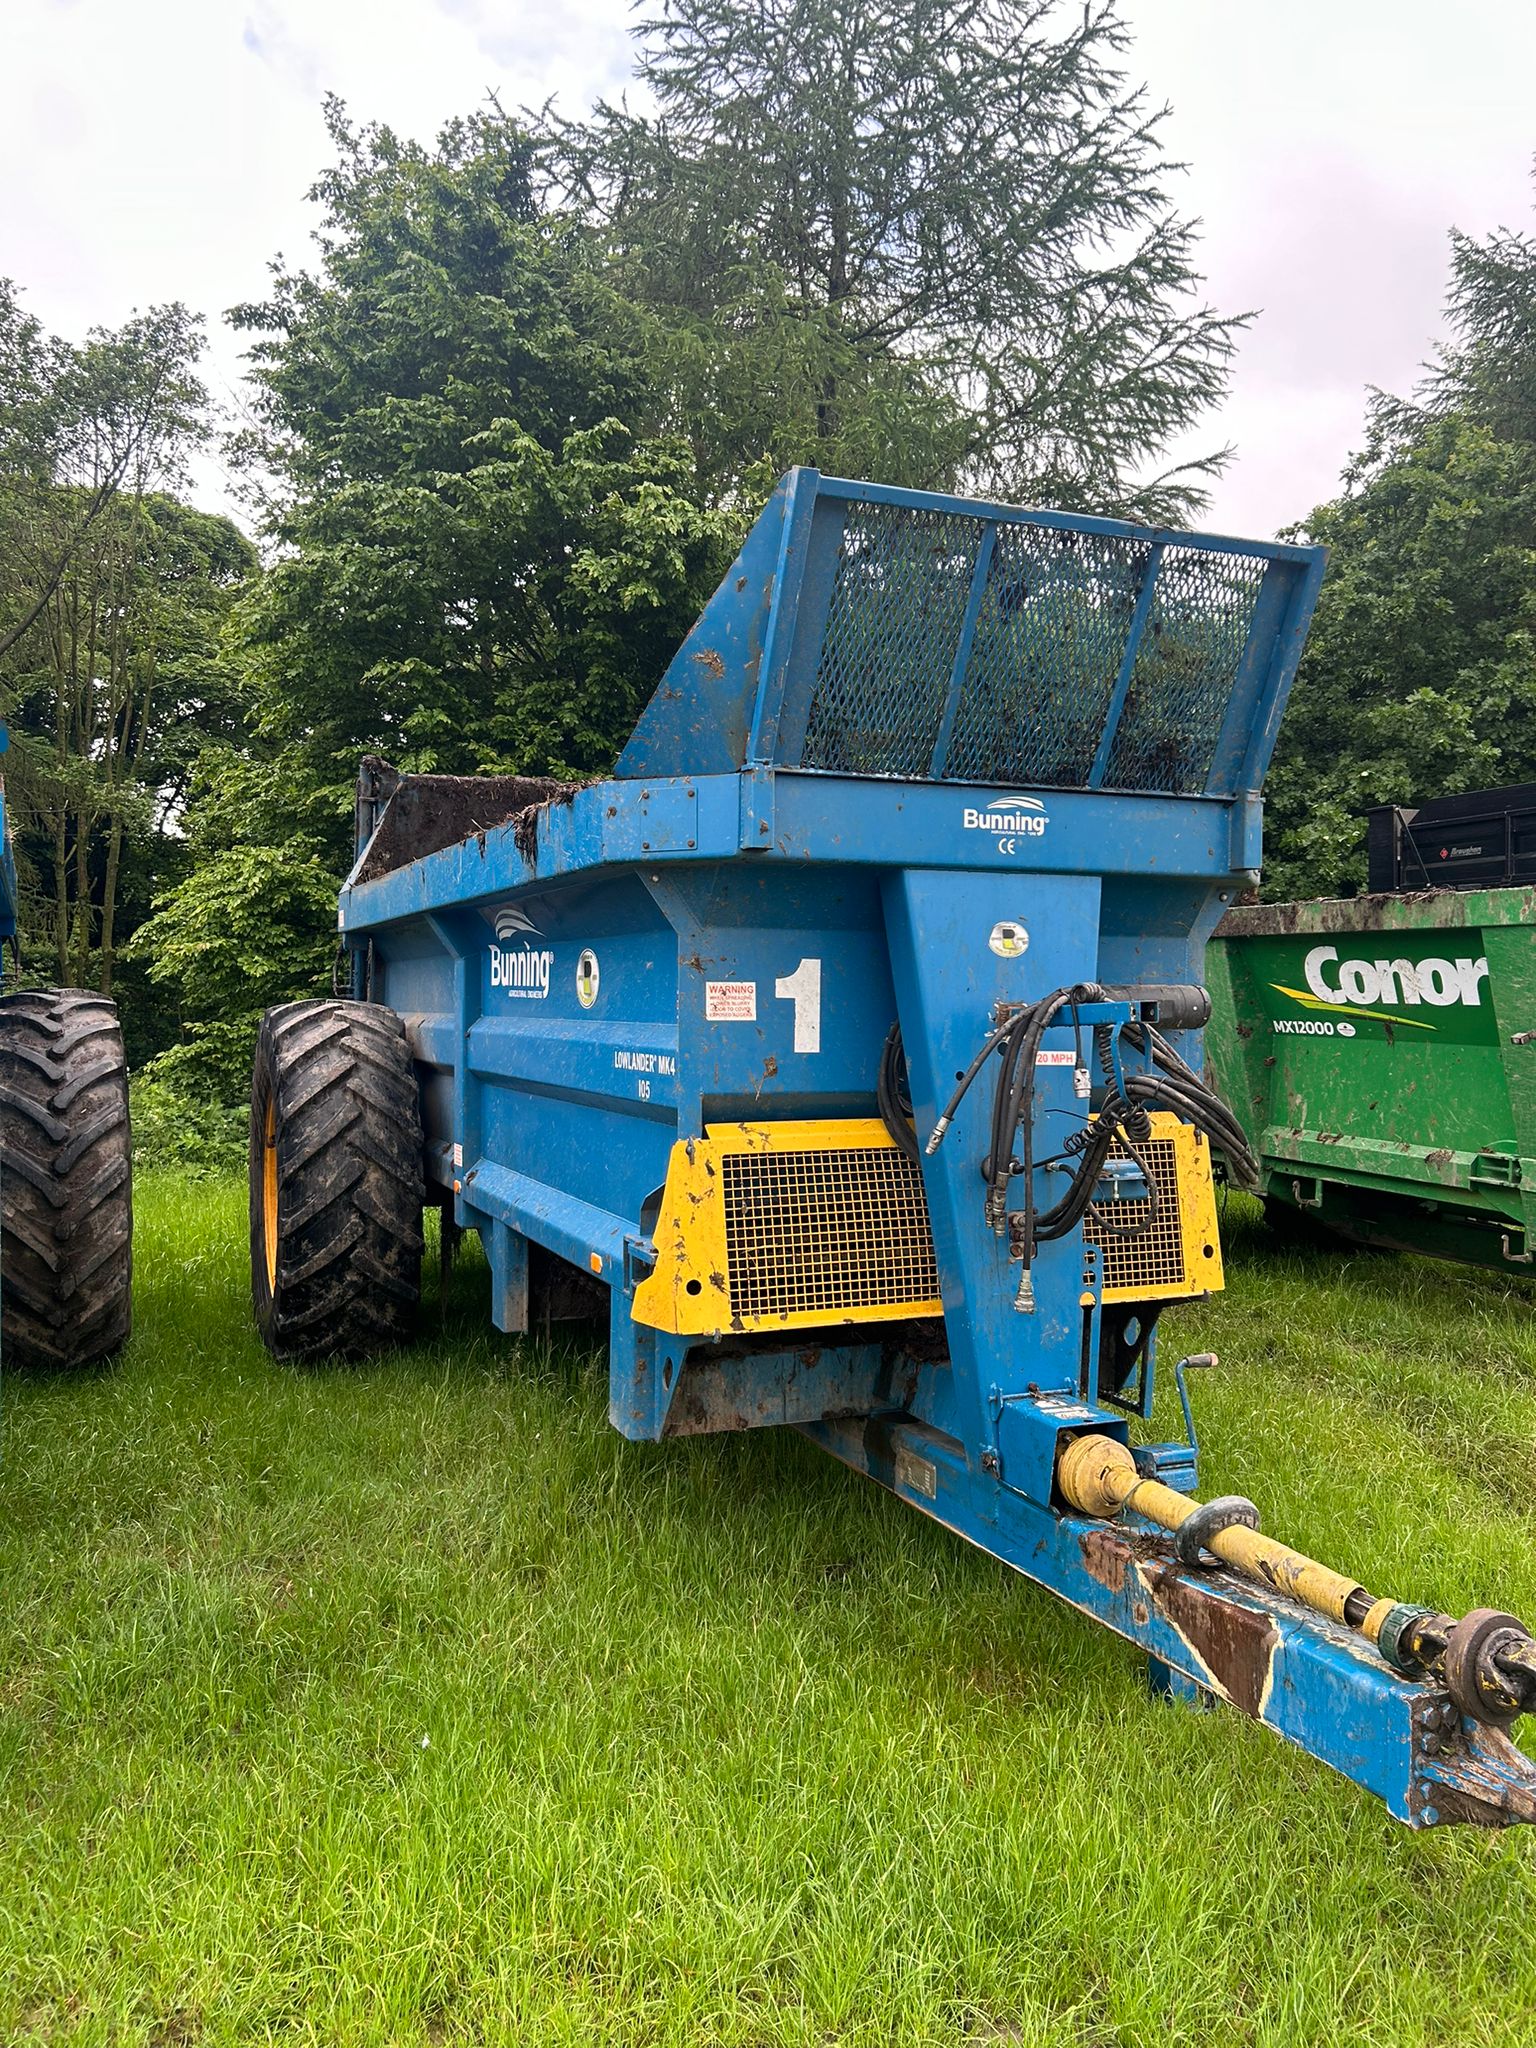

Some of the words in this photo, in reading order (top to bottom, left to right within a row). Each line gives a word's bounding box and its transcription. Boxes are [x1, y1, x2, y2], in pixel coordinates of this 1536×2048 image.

[963, 808, 1046, 836] Bunning
[998, 838, 1016, 855] CE
[488, 941, 550, 999] Bunning
[1304, 945, 1489, 1006] Conor
[709, 985, 754, 994] WARNING
[775, 958, 821, 1053] 1
[1273, 1020, 1334, 1036] MX12000
[614, 1050, 655, 1073] LOWLANDER
[658, 1055, 676, 1076] MK4
[1037, 1053, 1048, 1063] 20
[1051, 1053, 1073, 1063] MPH
